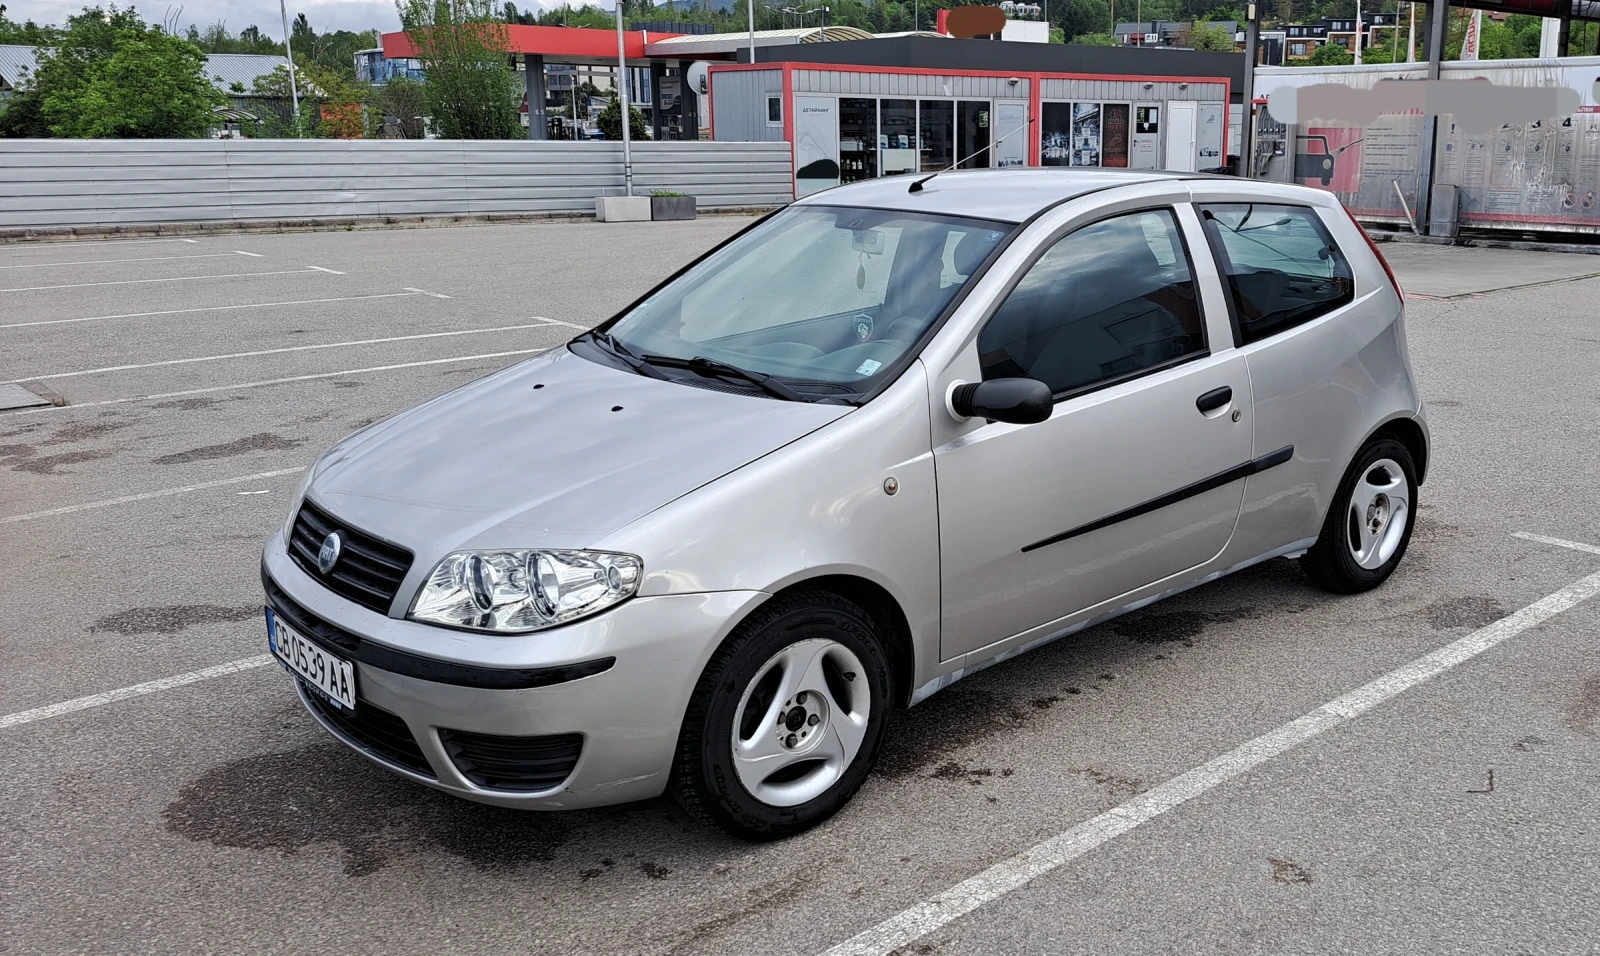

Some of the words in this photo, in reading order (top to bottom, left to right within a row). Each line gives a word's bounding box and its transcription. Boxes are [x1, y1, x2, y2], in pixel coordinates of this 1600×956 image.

[1562, 117, 1572, 127] 4
[275, 620, 291, 660] CB
[292, 634, 325, 686] 0539
[330, 660, 351, 704] AA
